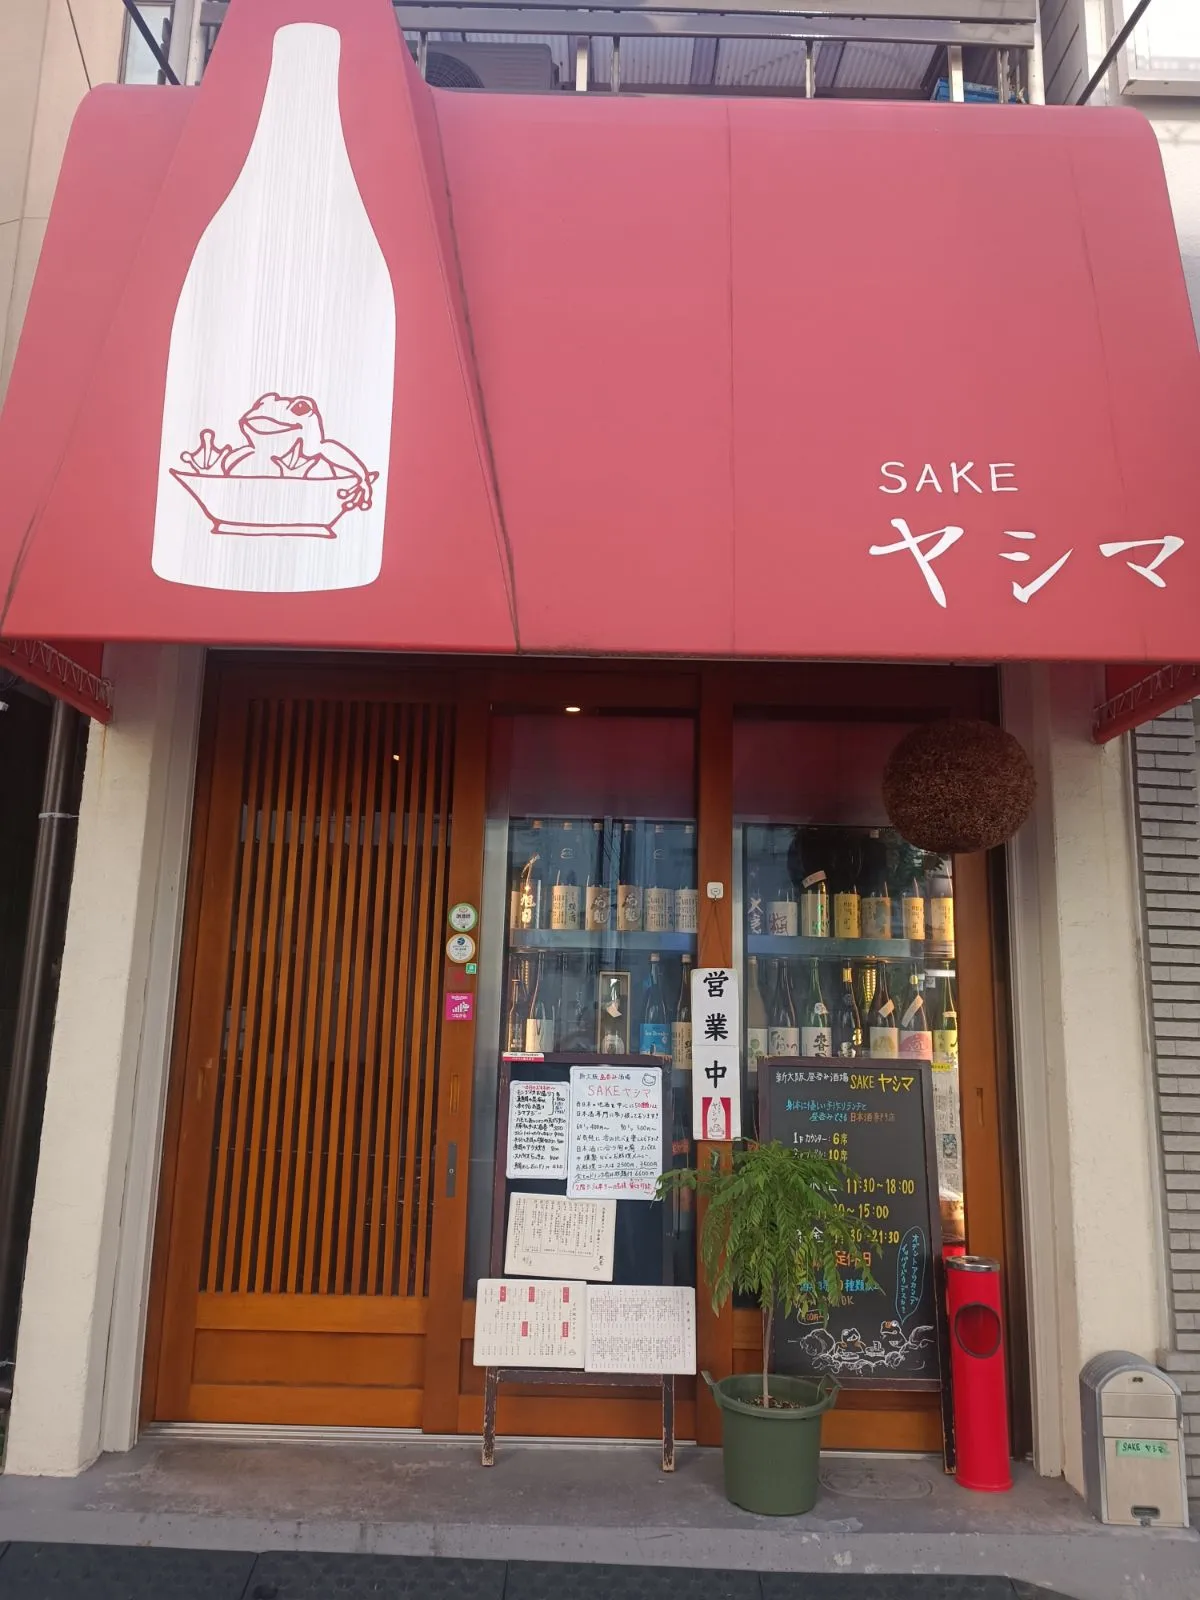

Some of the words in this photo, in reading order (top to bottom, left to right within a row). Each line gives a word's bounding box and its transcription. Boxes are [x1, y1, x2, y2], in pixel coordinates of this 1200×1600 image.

[879, 461, 1018, 493] SAKE
[869, 518, 1184, 608] ヤシマ
[703, 970, 729, 1088] 営業中
[587, 1085, 621, 1097] SAKE
[622, 1089, 652, 1098] ヤシマ
[850, 1074, 875, 1090] SAKE
[877, 1073, 914, 1093] ヤシマ
[1122, 1442, 1140, 1452] SAKE
